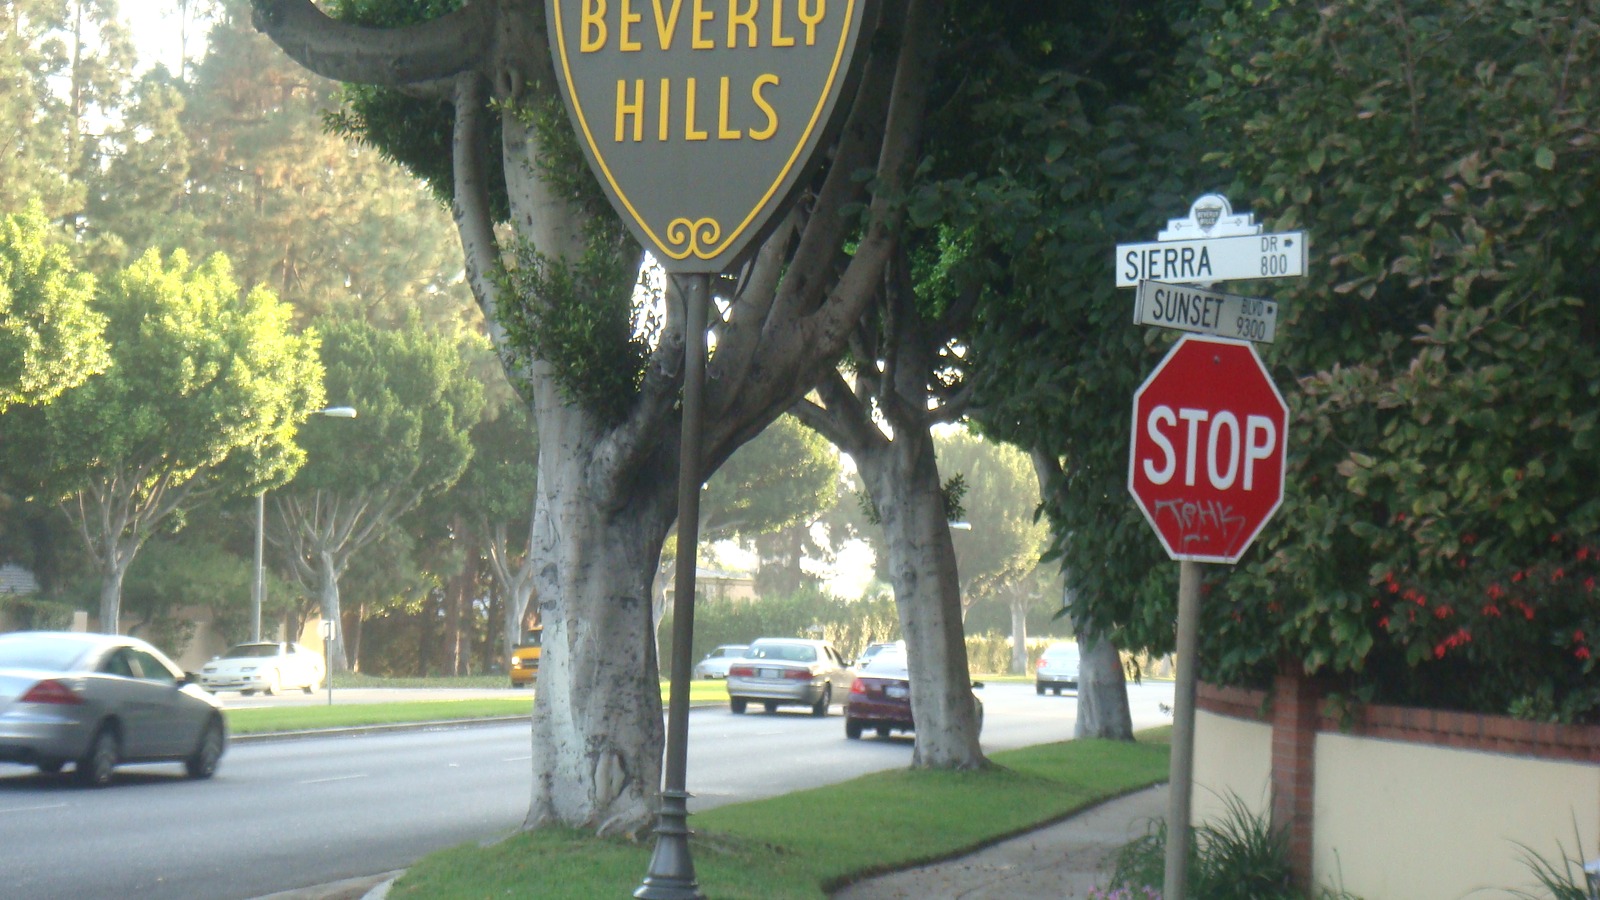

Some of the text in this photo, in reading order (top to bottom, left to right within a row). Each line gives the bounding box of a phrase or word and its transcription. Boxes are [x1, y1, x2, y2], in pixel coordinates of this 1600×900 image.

[580, 0, 826, 52] BEVERLY
[615, 73, 780, 142] HILLS
[1261, 236, 1278, 253] DR
[1125, 246, 1212, 281] SIERRA
[1260, 254, 1287, 276] 800
[1152, 289, 1224, 328] SUNSET
[1241, 298, 1263, 317] BLVD
[1236, 316, 1265, 340] 9300
[1143, 404, 1277, 491] STOP
